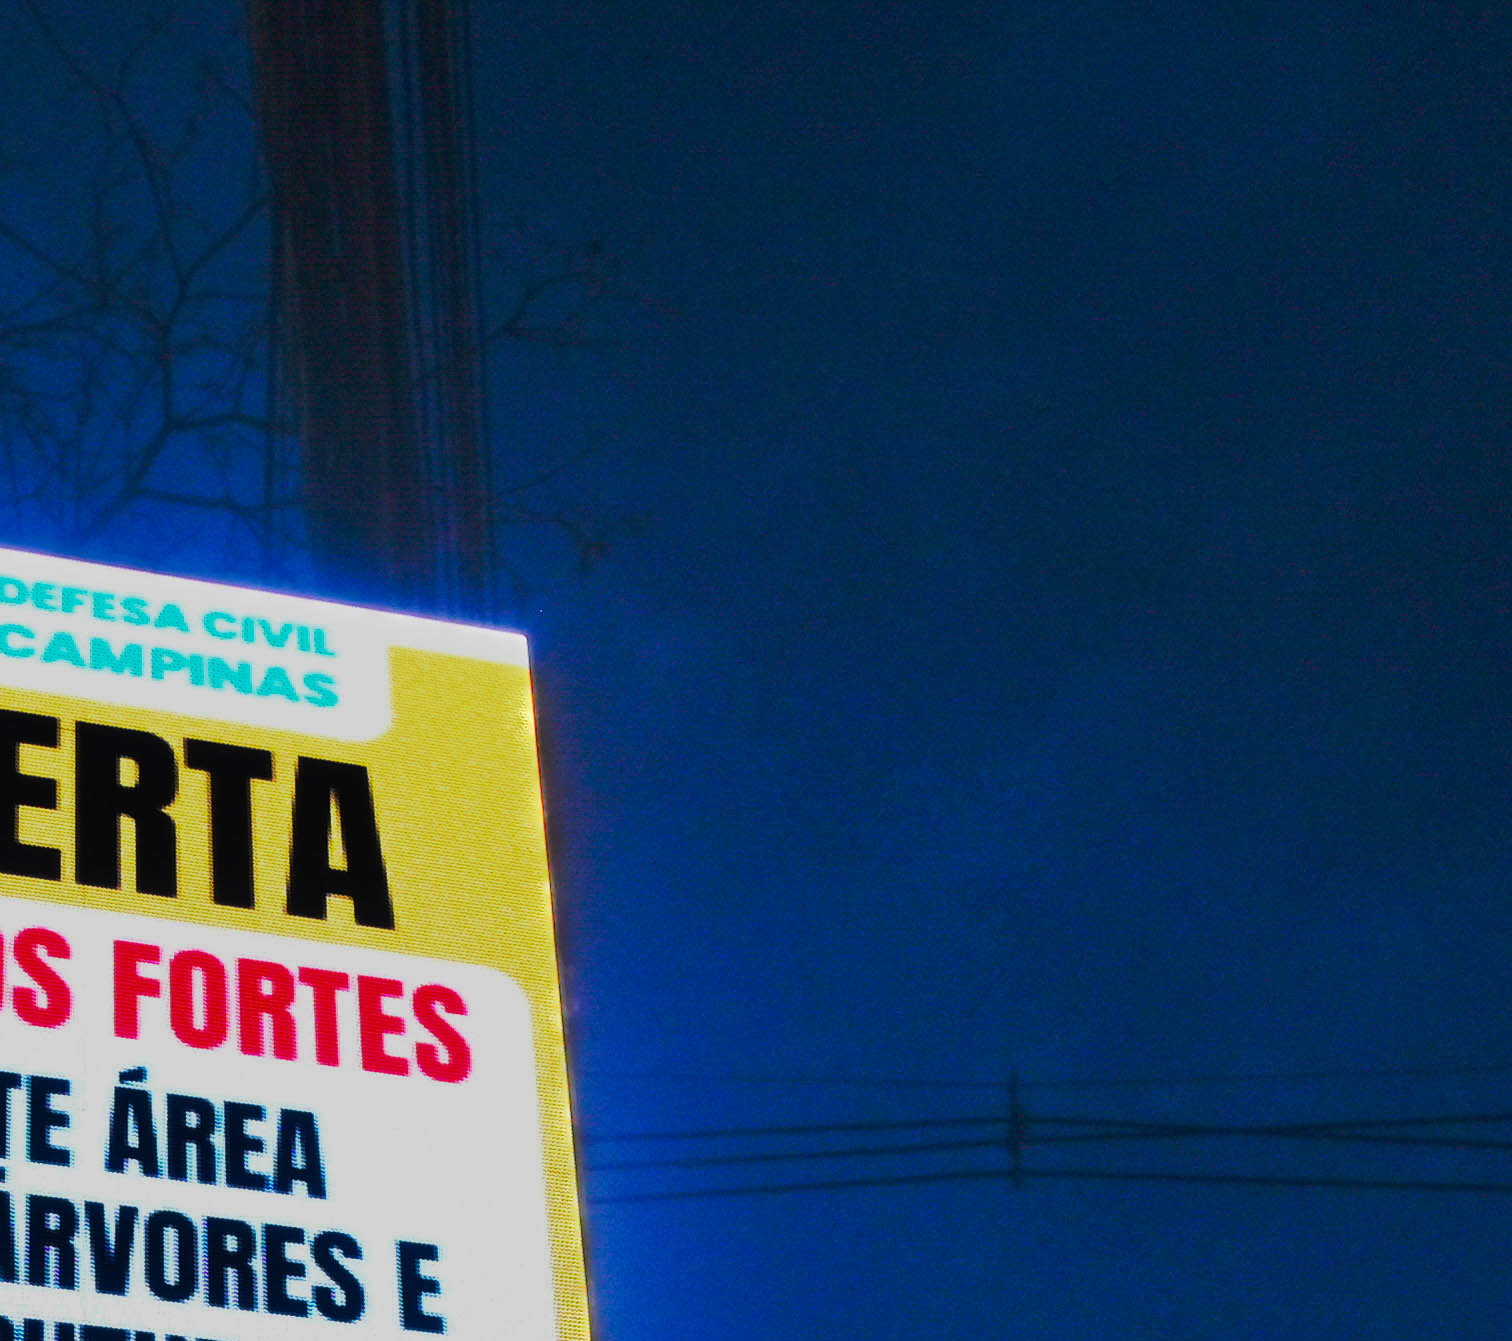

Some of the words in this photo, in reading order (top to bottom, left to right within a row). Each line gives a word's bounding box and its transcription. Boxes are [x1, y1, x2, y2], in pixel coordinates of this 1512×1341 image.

[202, 609, 337, 659] CIVIL
[111, 938, 473, 1085] FORTES
[104, 1065, 328, 1200] ÁREA
[396, 1239, 446, 1335] E
